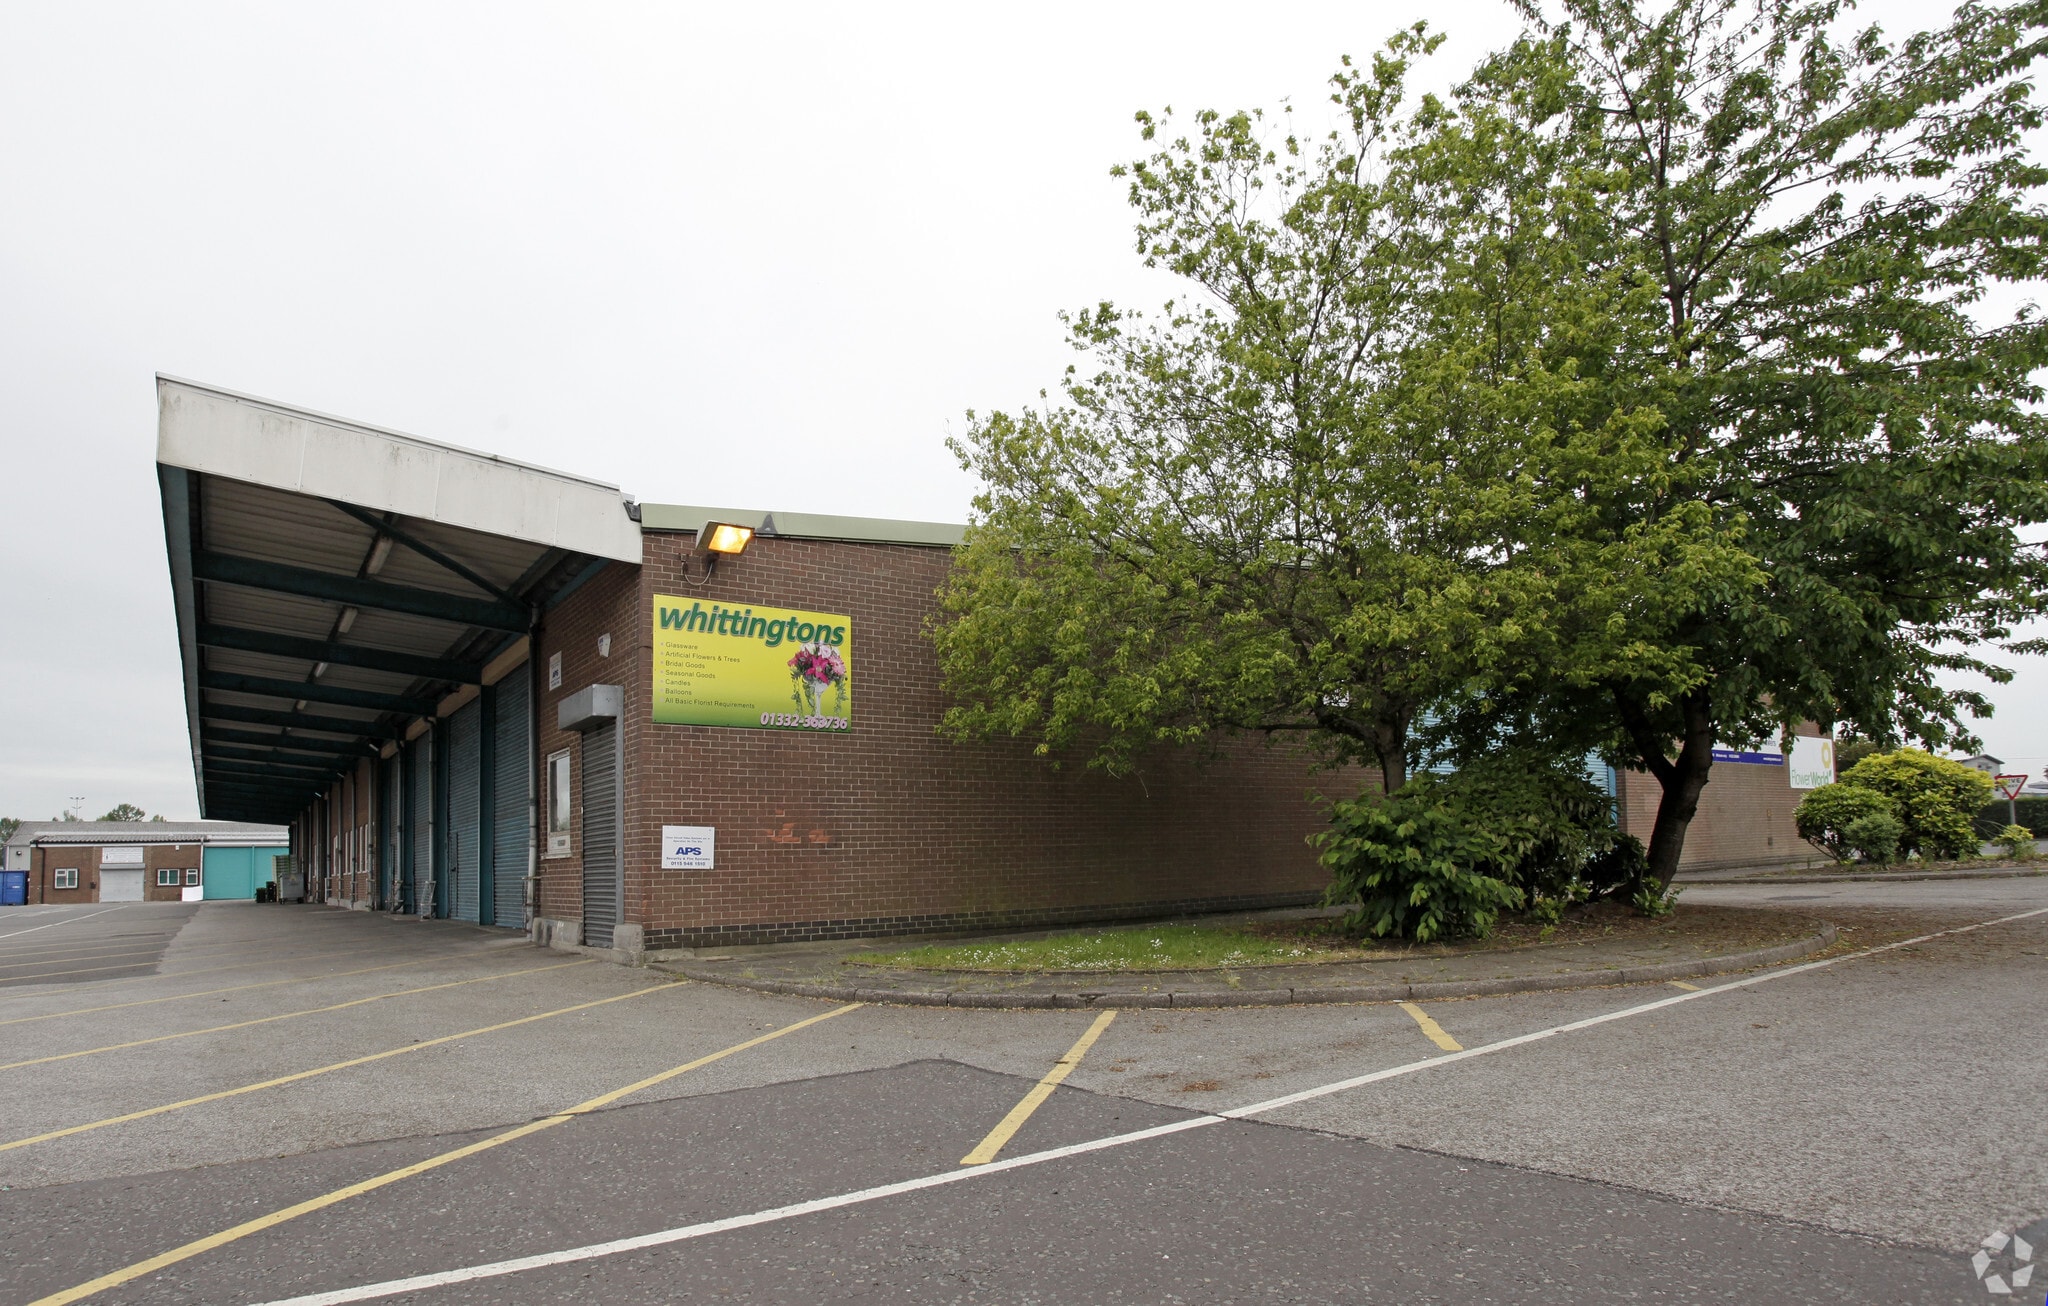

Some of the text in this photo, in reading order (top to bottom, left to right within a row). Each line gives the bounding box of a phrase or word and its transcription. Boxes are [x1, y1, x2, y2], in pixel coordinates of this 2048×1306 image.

[659, 602, 846, 647] whittingtons
[665, 642, 698, 650] Glassware
[665, 651, 691, 659] Artificial
[692, 653, 716, 661] Flowers
[714, 701, 755, 709] Requirements
[760, 711, 848, 730] 01332-363736
[1791, 769, 1829, 786] FlowerWorld
[676, 846, 702, 856] APS
